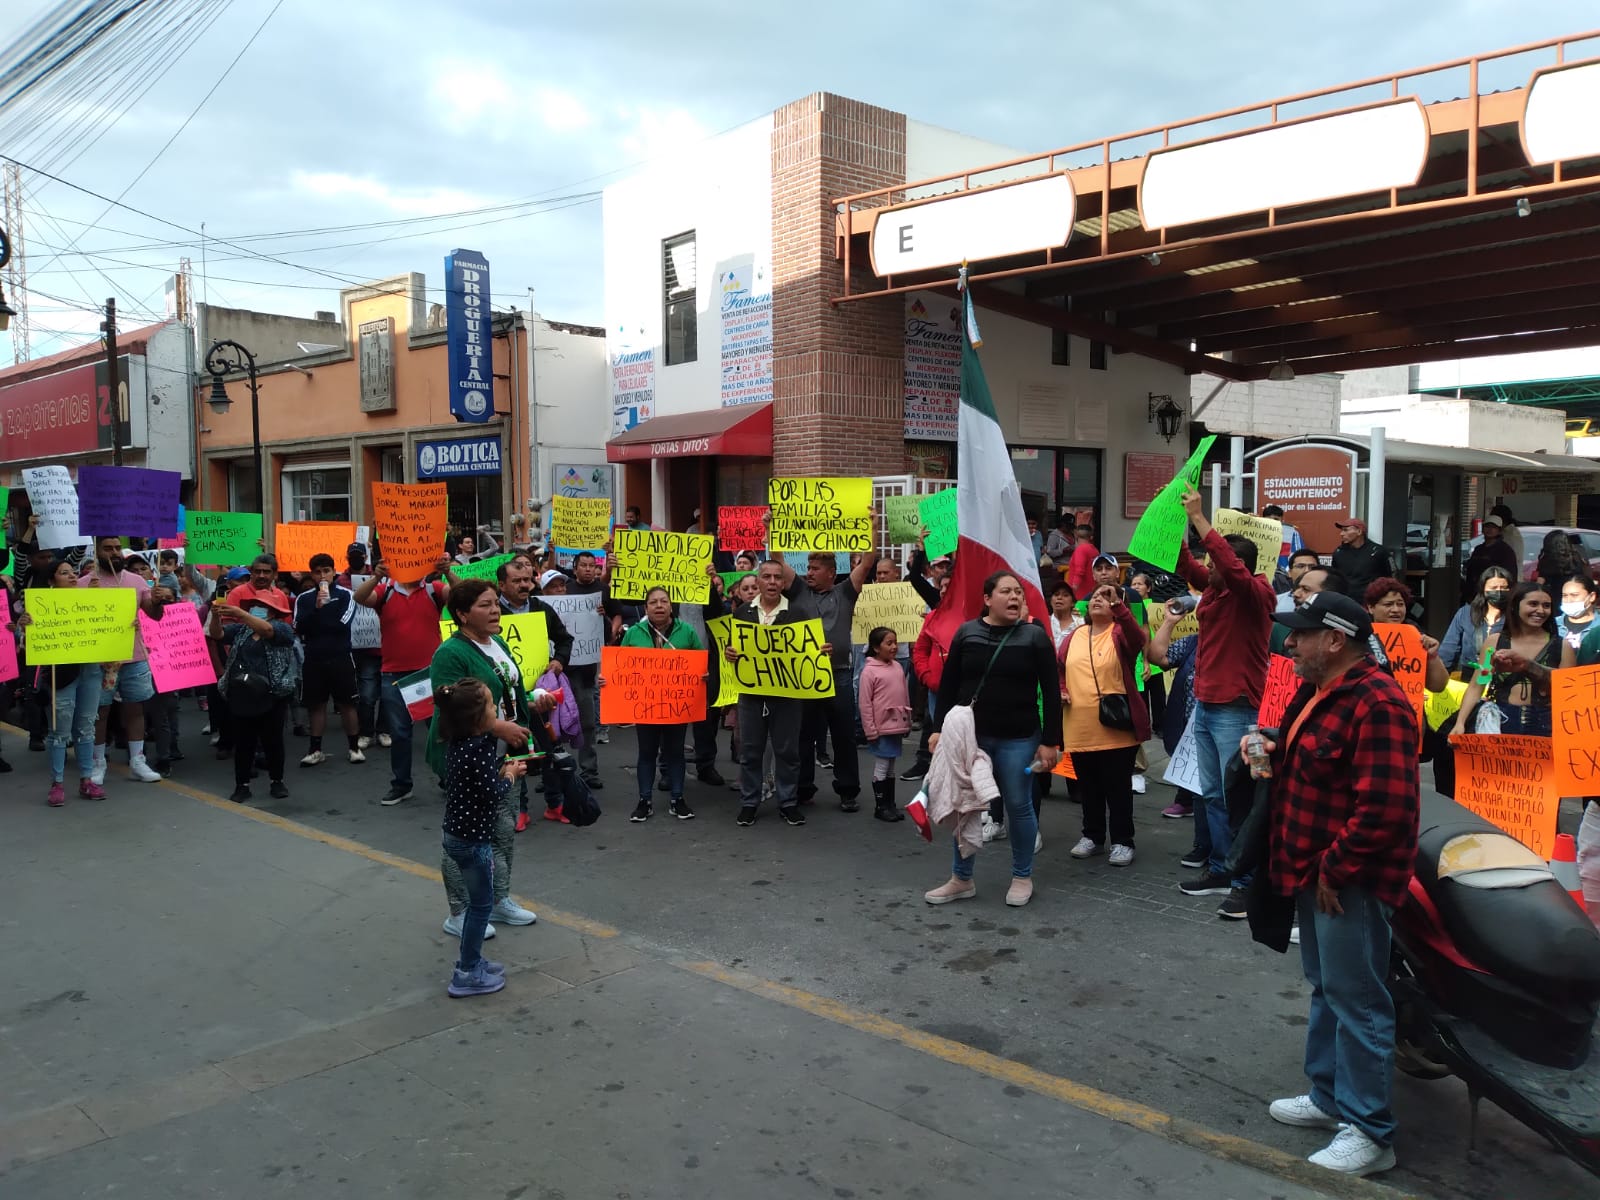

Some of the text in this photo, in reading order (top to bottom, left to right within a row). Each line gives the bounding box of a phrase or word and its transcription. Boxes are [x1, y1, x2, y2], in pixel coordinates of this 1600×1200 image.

[898, 224, 914, 253] E
[454, 260, 487, 271] FARMACIA
[721, 289, 770, 313] Famen
[722, 311, 735, 320] VENTA
[459, 381, 490, 390] CENTRAL
[904, 379, 933, 388] MAYOREO
[740, 394, 773, 402] SERVICIO
[912, 405, 958, 413] CELULARES
[437, 442, 499, 464] BOTICA
[650, 439, 709, 455] TORTAS DITO'S
[438, 462, 499, 473] FARMACIA CENTRAL
[1264, 477, 1343, 488] ESTACIONAMIENTO
[1502, 478, 1518, 494] NO
[770, 479, 835, 503] POR LAS
[771, 503, 843, 519] FAMILIAS
[1308, 502, 1314, 510] la
[1316, 502, 1342, 510] ciudad
[196, 516, 223, 526] FUERA
[390, 512, 425, 521] MUCHAS
[772, 518, 870, 531] TULANCINGUENSES
[903, 514, 919, 526] NO
[192, 528, 247, 539] EMPRESAS
[412, 523, 432, 532] POR
[196, 541, 235, 552] CHINAS
[615, 530, 711, 560] TULANCINGO
[720, 538, 747, 550] FUERA
[771, 531, 872, 551] FUERA CHINOS
[647, 554, 663, 571] DE
[669, 557, 698, 576] LOS
[35, 596, 50, 616] Si
[736, 624, 820, 656] FUERA
[616, 650, 690, 671] Comerciante
[651, 672, 700, 687] en contra
[734, 652, 832, 693] CHINOS
[625, 687, 695, 705] de la plaza
[634, 702, 694, 720] CHINA
[1472, 776, 1544, 800] NO VIENEN A
[1460, 786, 1545, 815] GENERAR EMPLEO
[1485, 806, 1532, 827] VIENEN A
